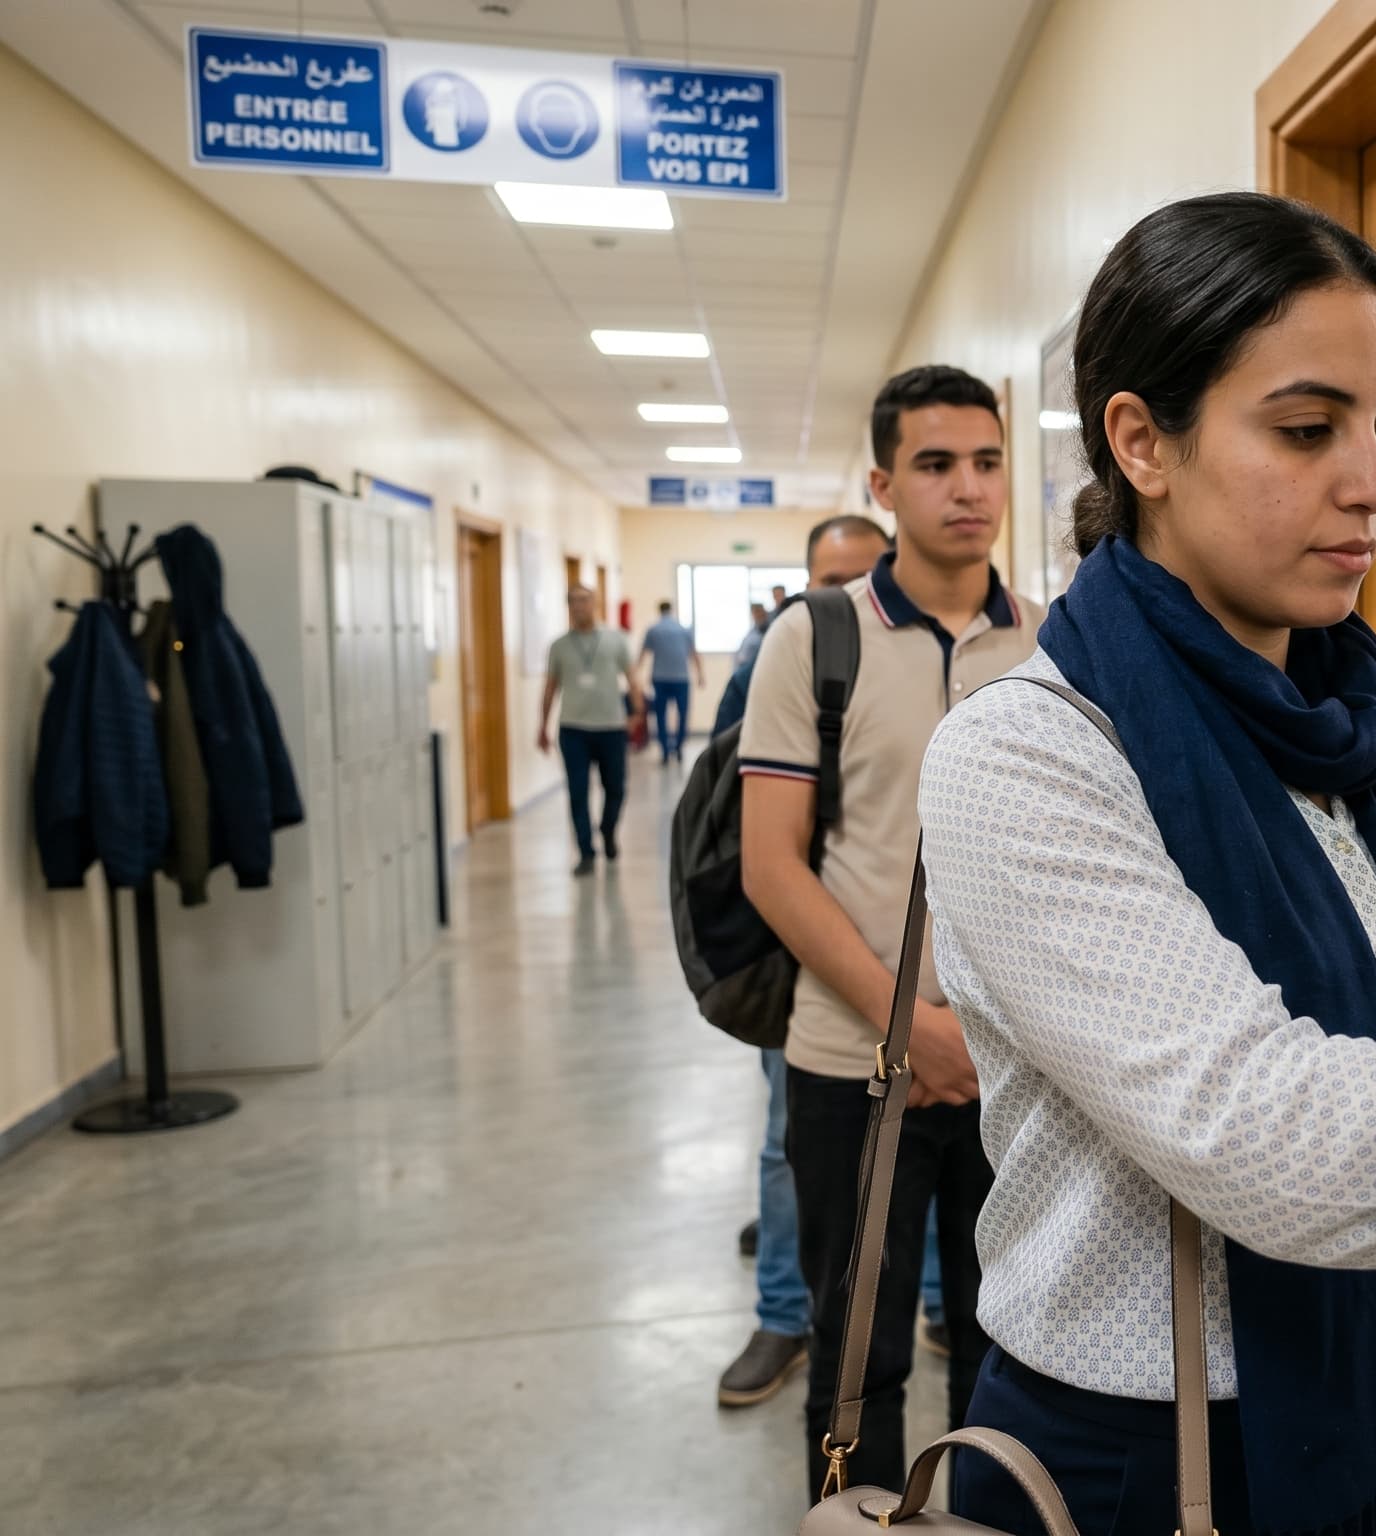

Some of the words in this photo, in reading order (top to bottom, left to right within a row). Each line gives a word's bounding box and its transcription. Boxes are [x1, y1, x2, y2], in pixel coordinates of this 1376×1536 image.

[234, 93, 348, 125] ENTRÉE
[205, 122, 379, 156] PERSONNEL
[647, 131, 749, 160] PORTEZ
[647, 157, 702, 182] VOS
[706, 160, 749, 186] EPI
